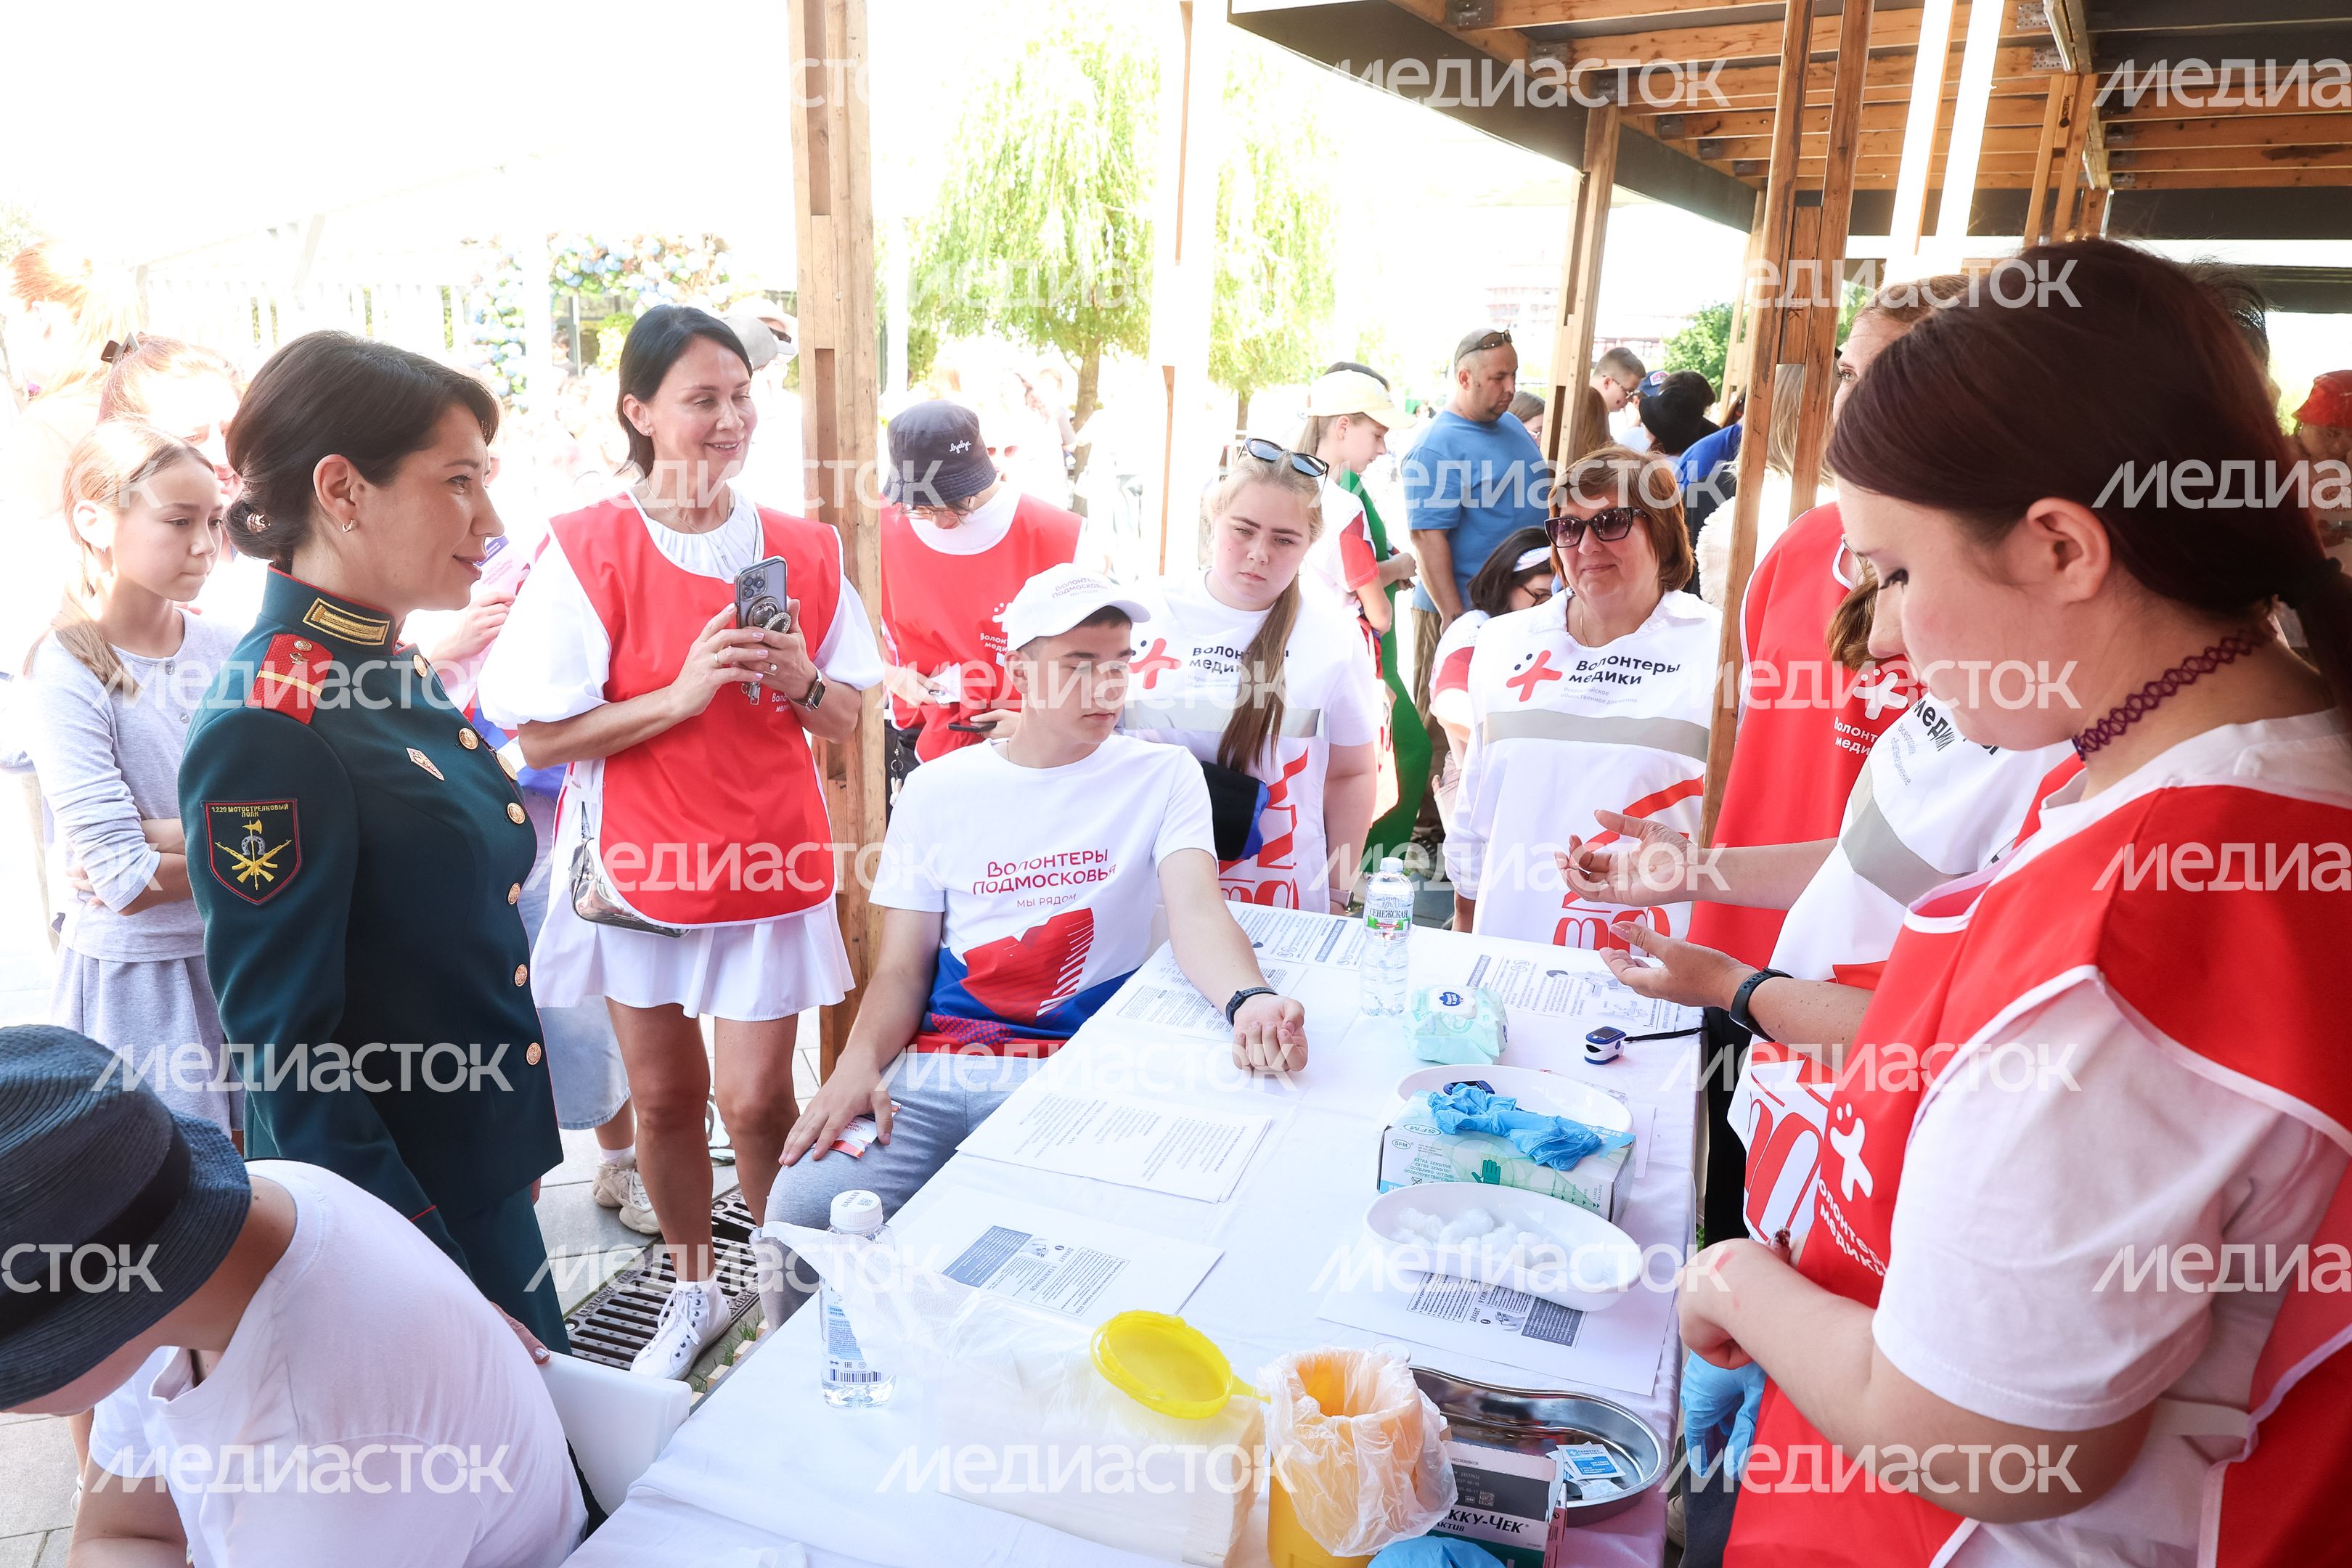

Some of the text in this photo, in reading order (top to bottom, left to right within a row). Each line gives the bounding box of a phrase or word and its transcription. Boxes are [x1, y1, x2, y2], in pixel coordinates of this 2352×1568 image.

[980, 632, 1008, 645] Волон
[1575, 655, 1681, 676] Волонтеры
[1568, 671, 1642, 685] медики
[1016, 892, 1078, 909] МЫ РЯДОМ
[1370, 908, 1408, 919] СЕНЕЖСКАЯ
[1409, 1125, 1436, 1135] SFM
[1469, 1307, 1480, 1322] ДИАБЕТ
[1445, 1509, 1530, 1534] ККУ-ЧЕК®
